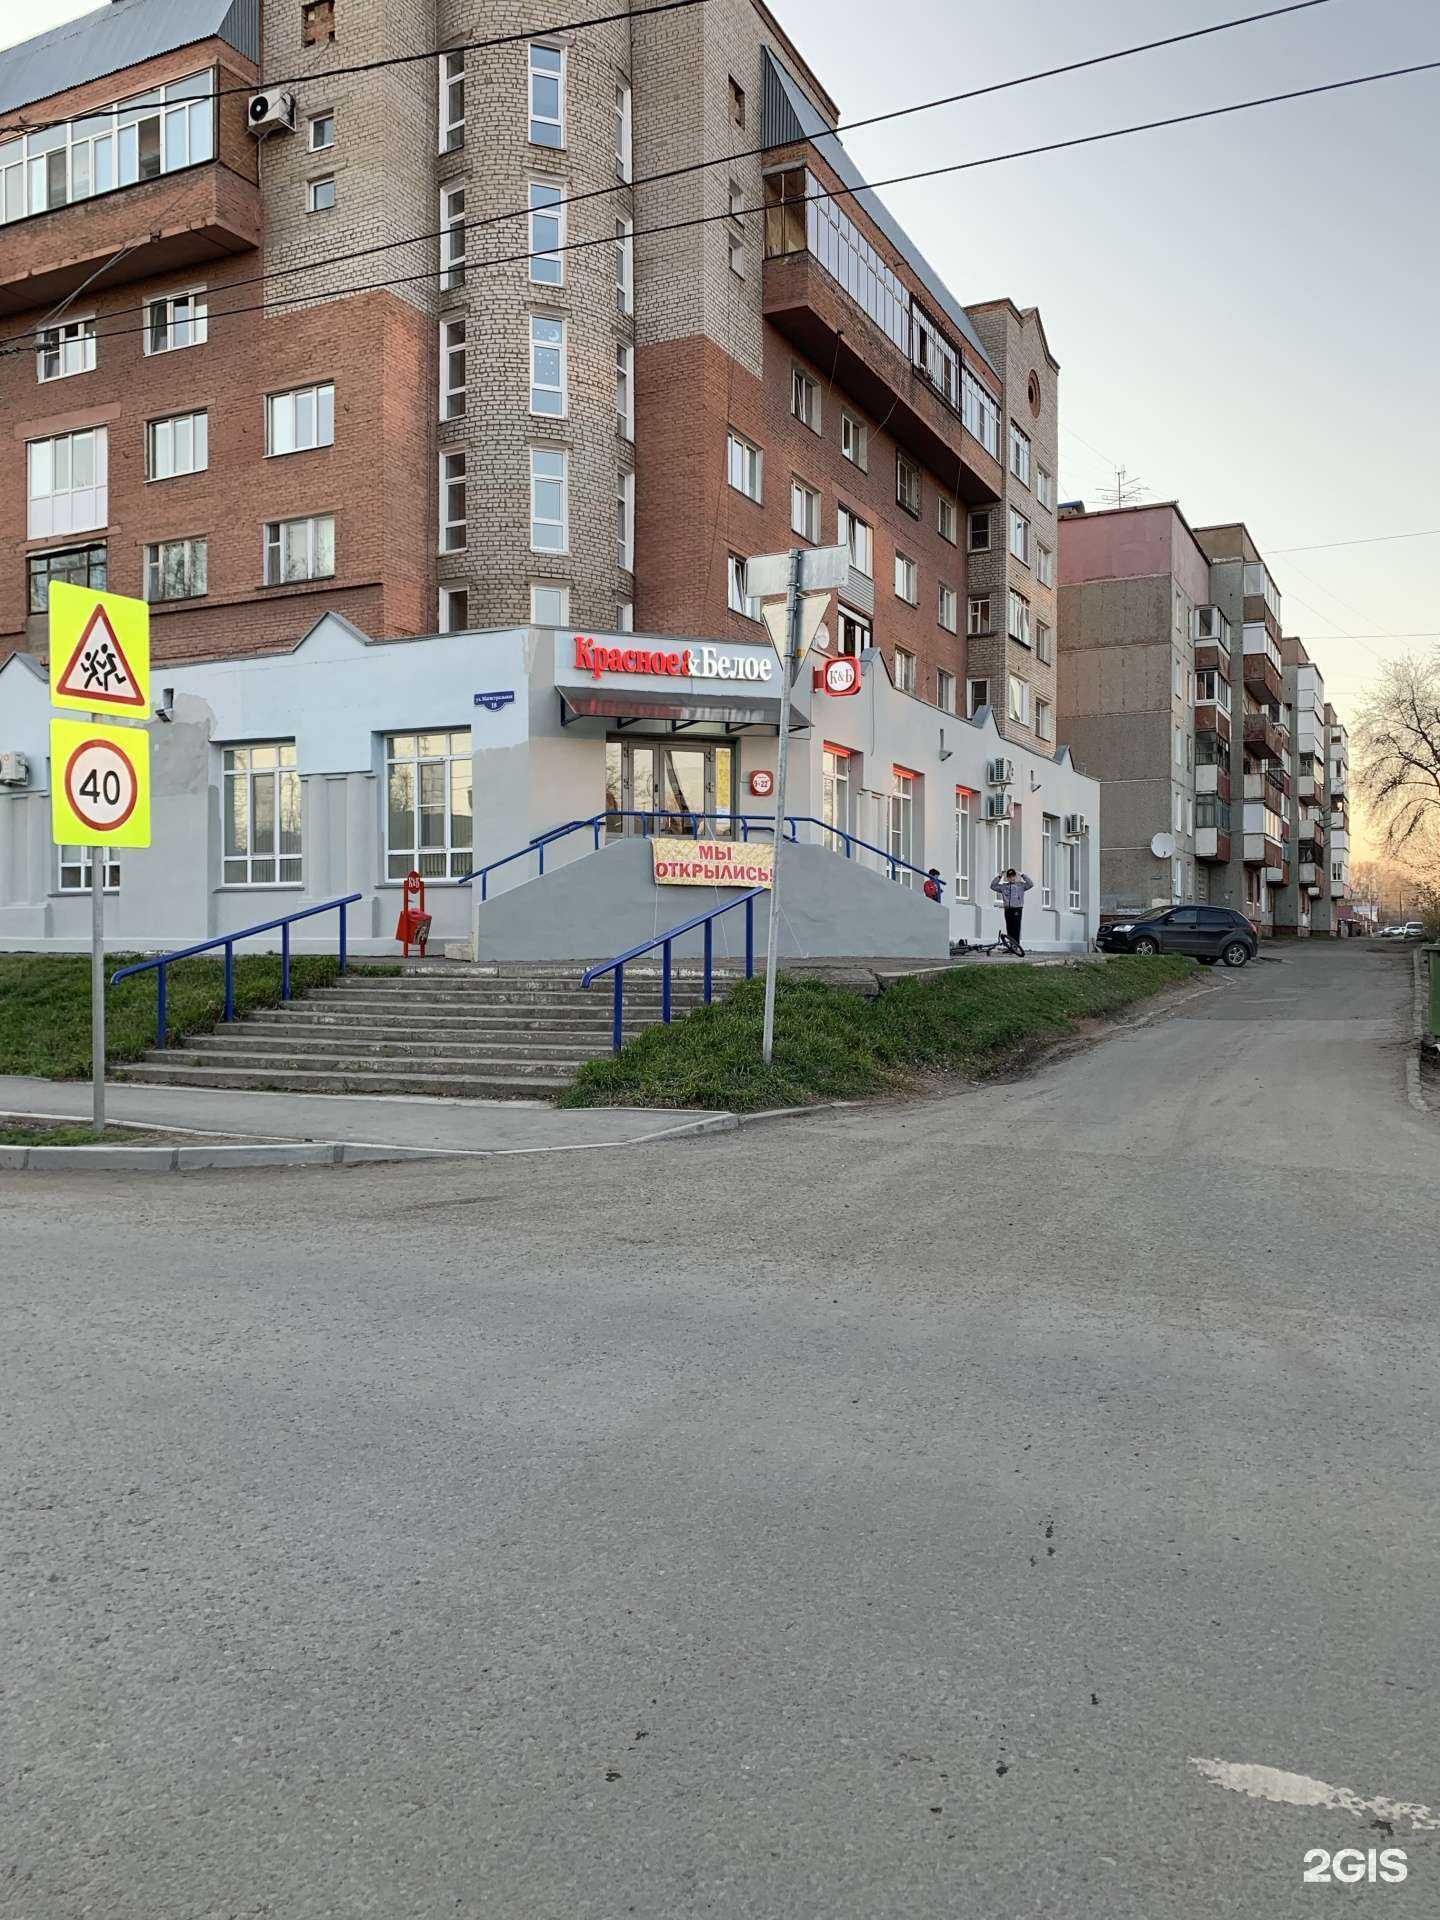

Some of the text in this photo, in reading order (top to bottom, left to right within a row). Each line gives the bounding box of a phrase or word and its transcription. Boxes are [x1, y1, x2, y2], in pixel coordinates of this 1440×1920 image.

[829, 668, 853, 685] К&Б
[78, 768, 121, 805] 40
[698, 845, 733, 861] МЫ
[655, 862, 773, 883] ОТКРЫЛИСЬ!
